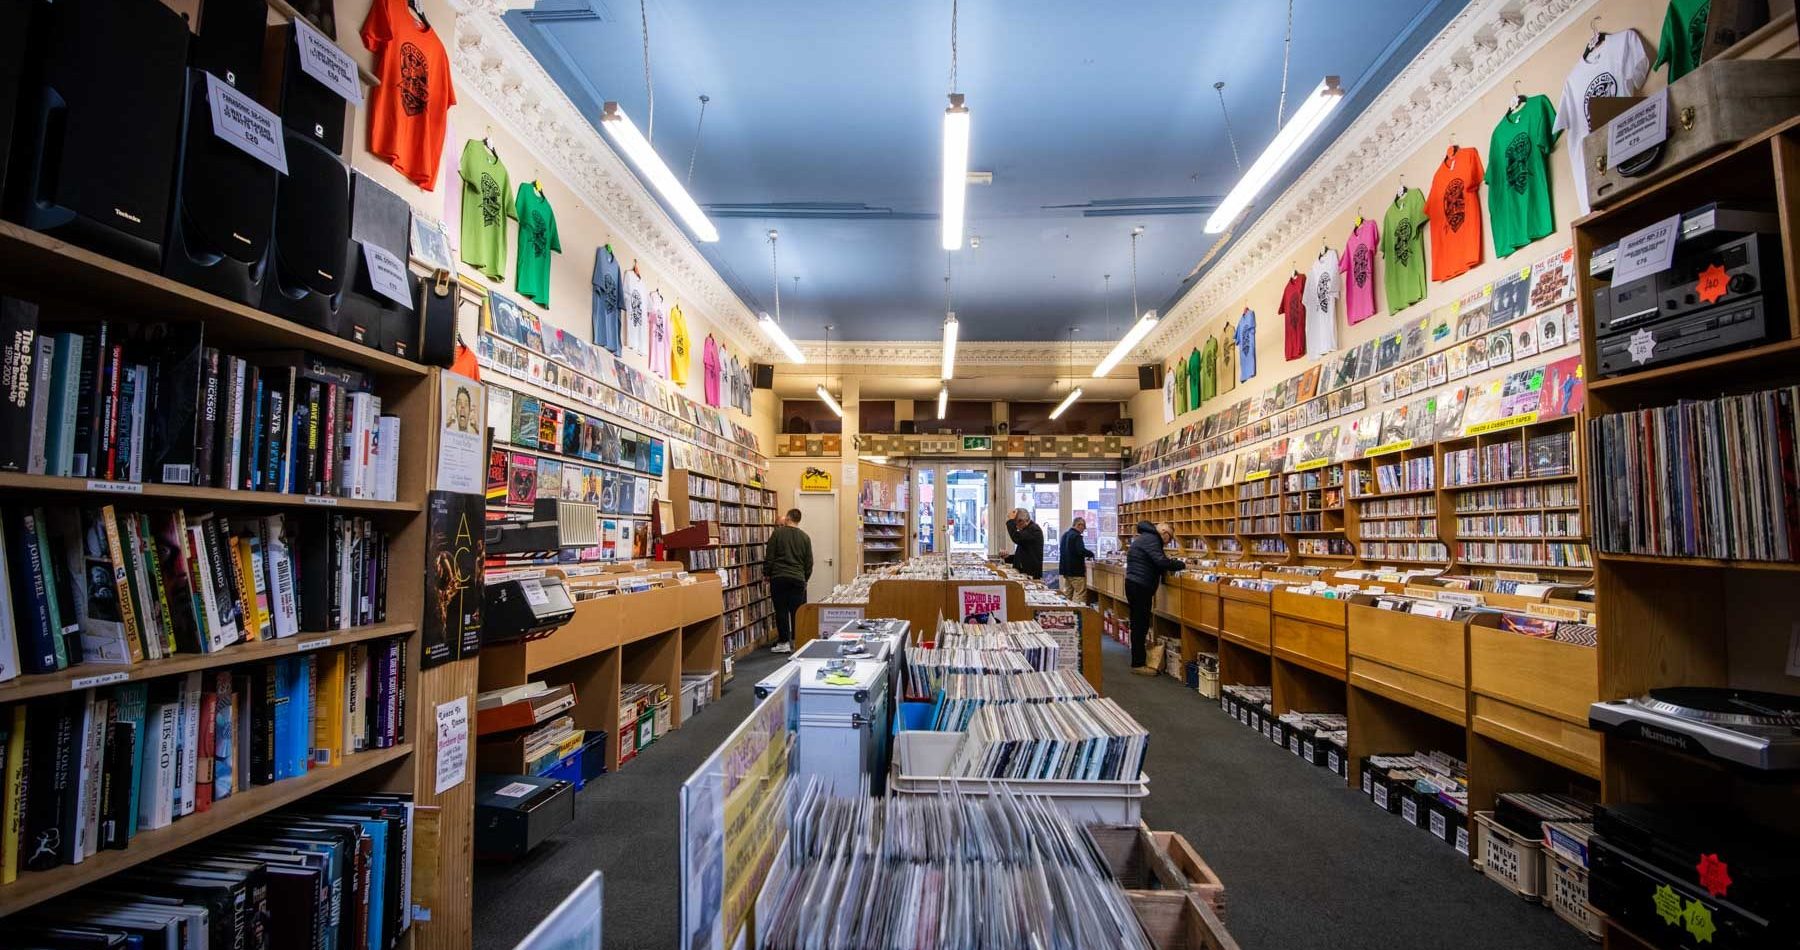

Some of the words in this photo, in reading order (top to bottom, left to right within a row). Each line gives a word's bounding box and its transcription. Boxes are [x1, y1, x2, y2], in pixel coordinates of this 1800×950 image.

[245, 132, 259, 145] £20
[114, 208, 141, 223] Technics
[13, 331, 22, 351] After
[21, 329, 33, 354] The
[2, 346, 13, 385] 1970-2000
[9, 367, 19, 402] Break-Up
[17, 356, 31, 408] Beatles
[206, 377, 215, 421] DICKSON
[310, 402, 318, 419] DAVE
[308, 421, 317, 450] FANNING
[1491, 419, 1514, 429] CASSETTE
[27, 543, 41, 572] JOHN
[207, 521, 216, 545] KEITH
[212, 546, 225, 588] RICHARDS
[32, 573, 44, 599] PEEL
[277, 560, 291, 593] SINATRA
[238, 567, 250, 621] ROLLING
[964, 592, 986, 603] RECORD
[120, 583, 132, 615] Happy
[126, 618, 138, 642] Days
[966, 603, 1000, 615] FAIR
[116, 705, 144, 722] YOUNG
[162, 708, 172, 739] BLUES
[62, 716, 72, 743] NEIL
[1641, 726, 1687, 749] Numark
[162, 741, 168, 751] on
[58, 746, 70, 790] YOUNG
[161, 753, 169, 768] CD
[1488, 840, 1517, 862] TWELVE
[1488, 849, 1517, 872] INCH
[1488, 860, 1516, 882] SINGLES
[332, 878, 342, 894] U2
[1555, 873, 1586, 898] TWELVE
[330, 895, 342, 926] SHOW
[1556, 894, 1586, 920] SINGLES
